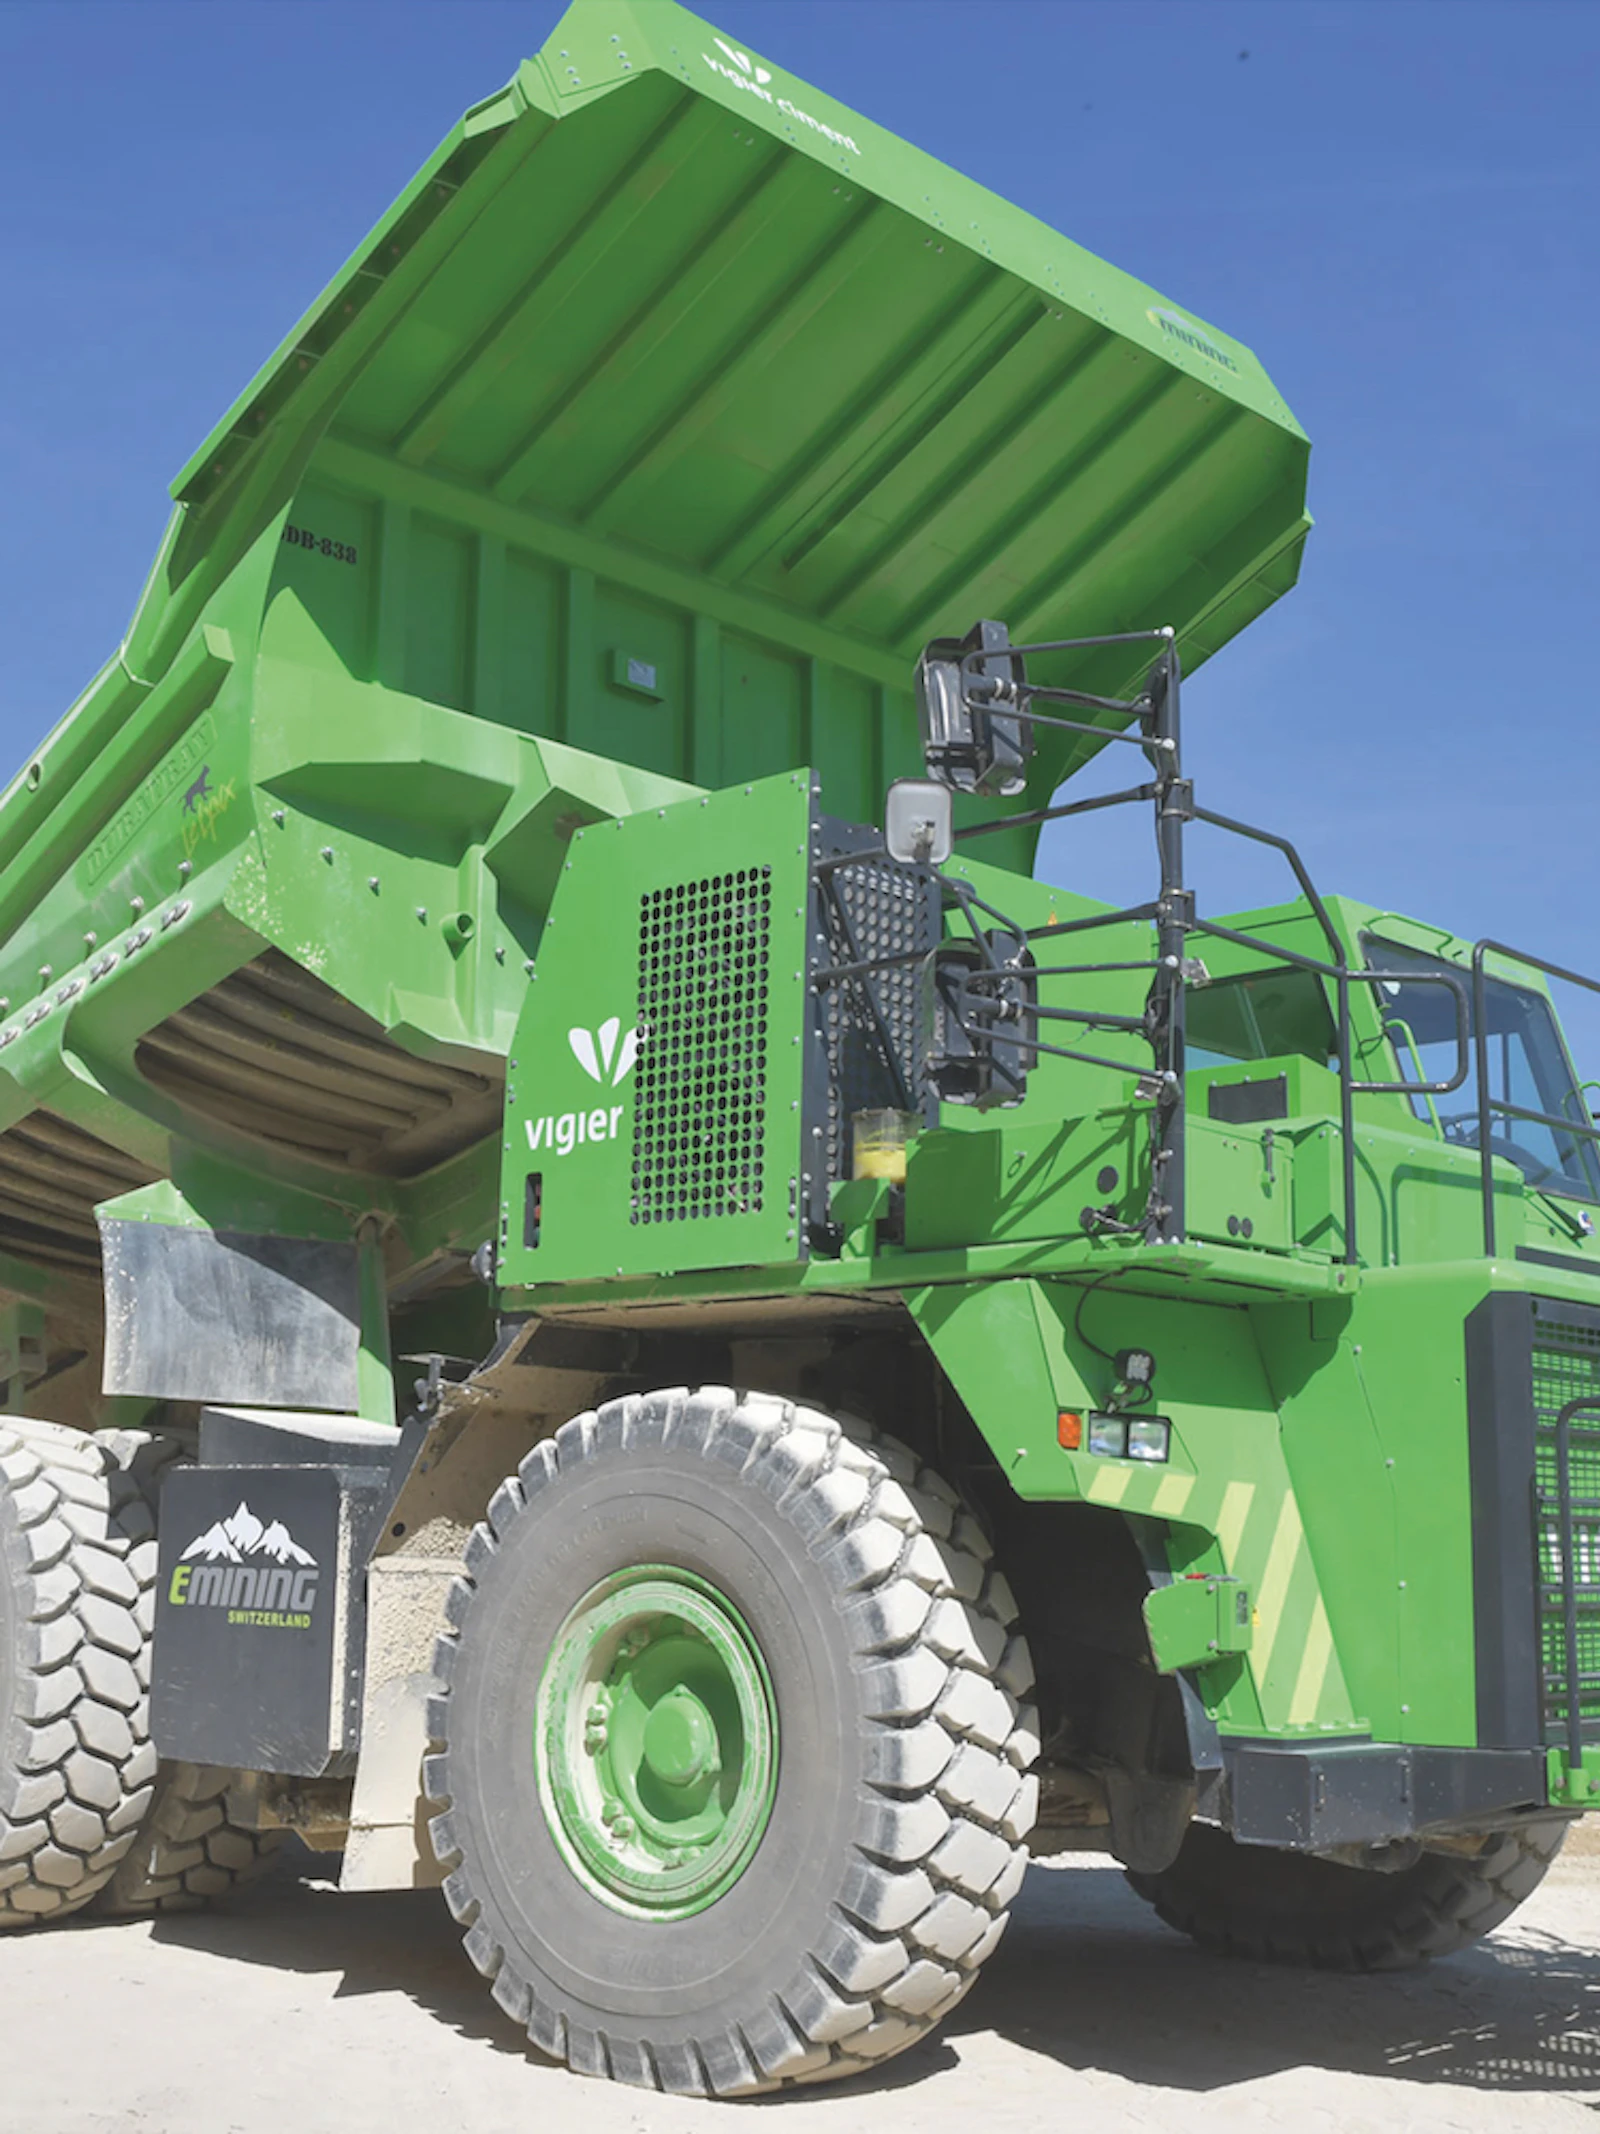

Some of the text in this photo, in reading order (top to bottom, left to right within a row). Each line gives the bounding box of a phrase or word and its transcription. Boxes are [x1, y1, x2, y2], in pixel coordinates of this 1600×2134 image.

[281, 524, 357, 565] DB-838
[524, 1105, 624, 1156] vigier
[168, 1565, 320, 1612] EMINING
[227, 1610, 311, 1629] SWITZERLAND
